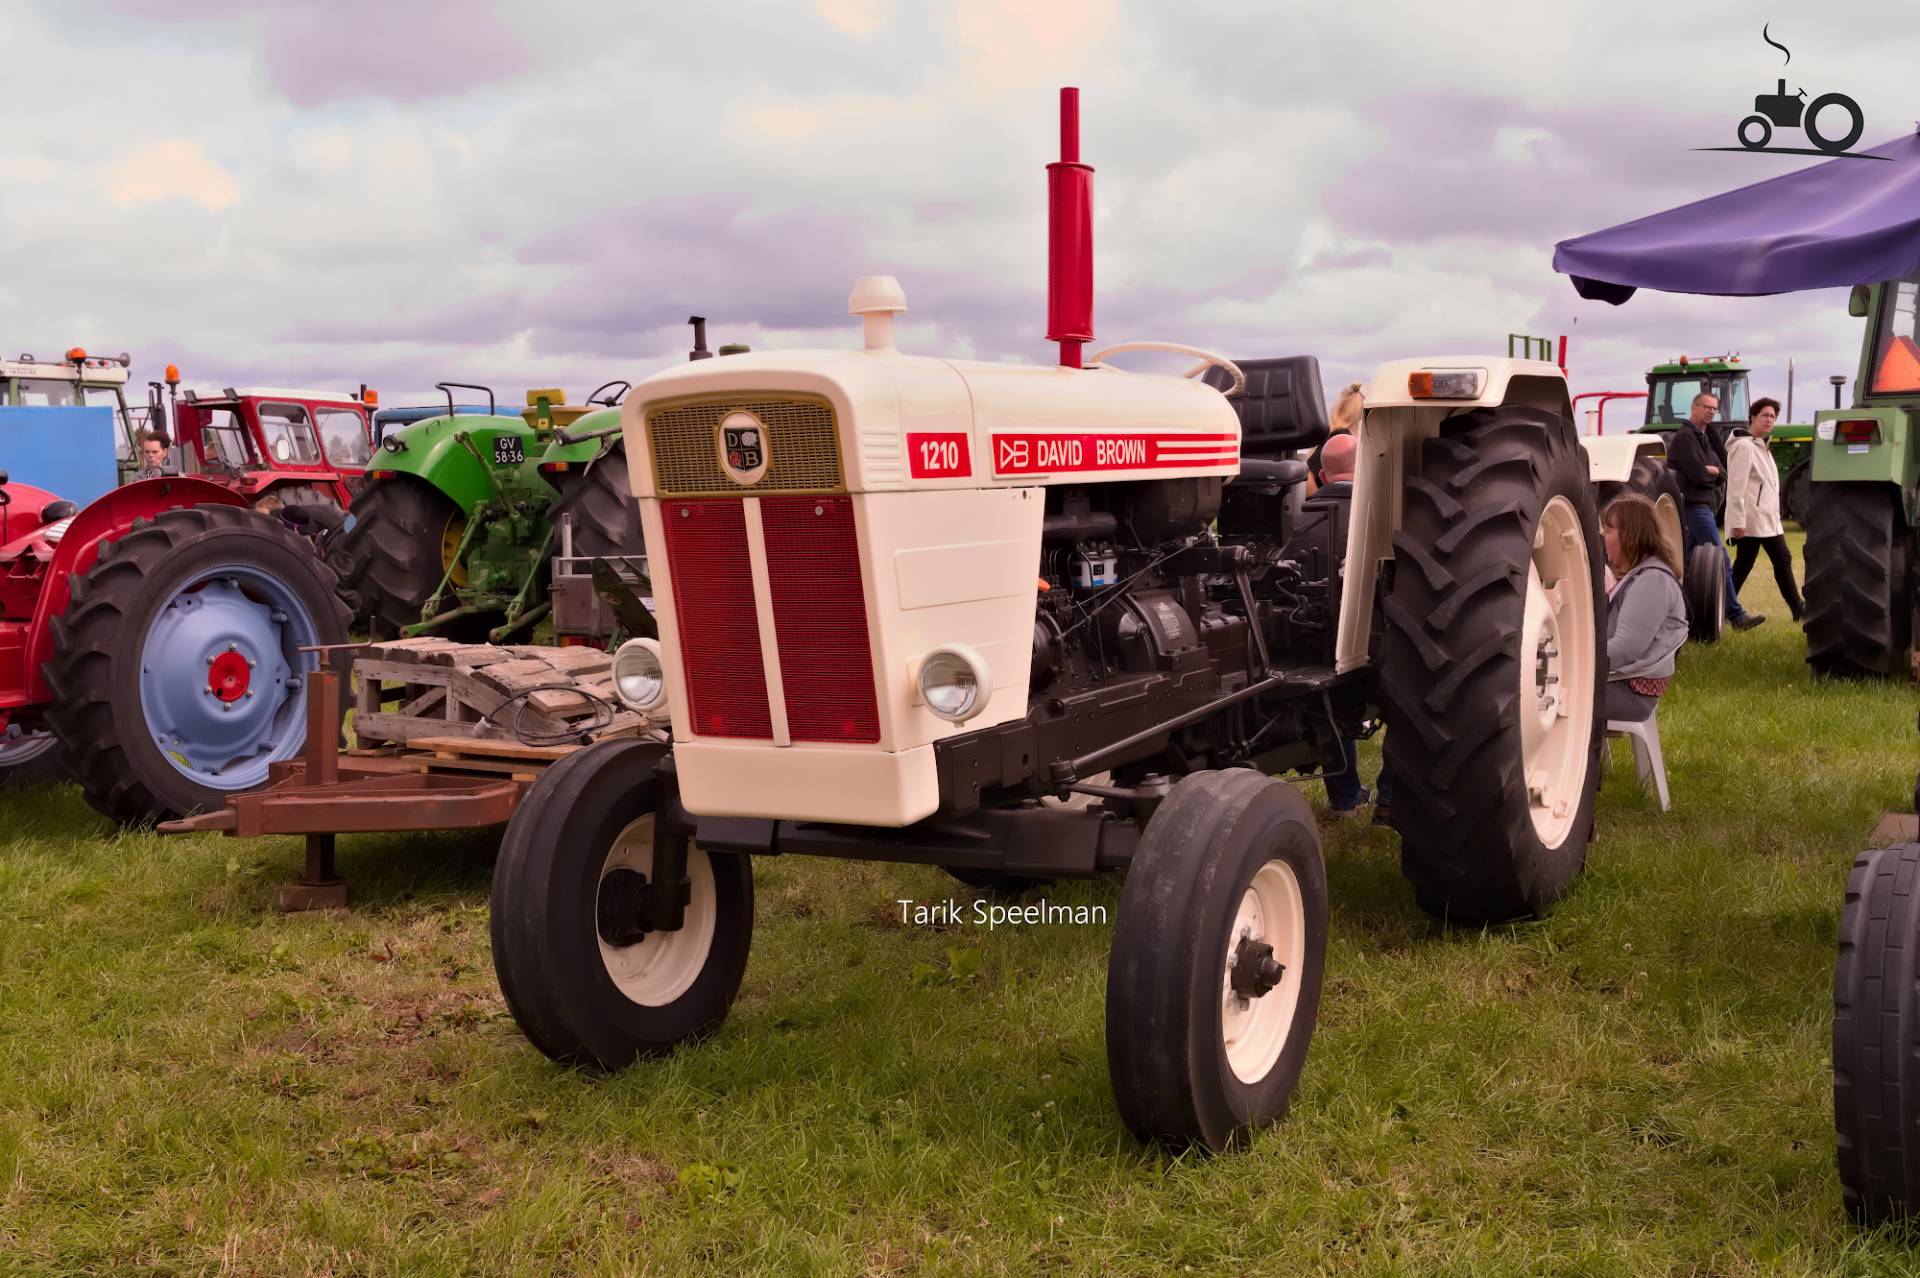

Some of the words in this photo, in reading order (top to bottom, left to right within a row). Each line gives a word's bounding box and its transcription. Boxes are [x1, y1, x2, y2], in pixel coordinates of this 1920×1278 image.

[500, 437, 515, 450] GV
[727, 432, 739, 448] D
[495, 450, 524, 463] 58-36
[743, 451, 760, 467] B
[920, 440, 959, 470] 1210
[1037, 440, 1083, 467] DAVID
[1096, 439, 1147, 466] BROWN
